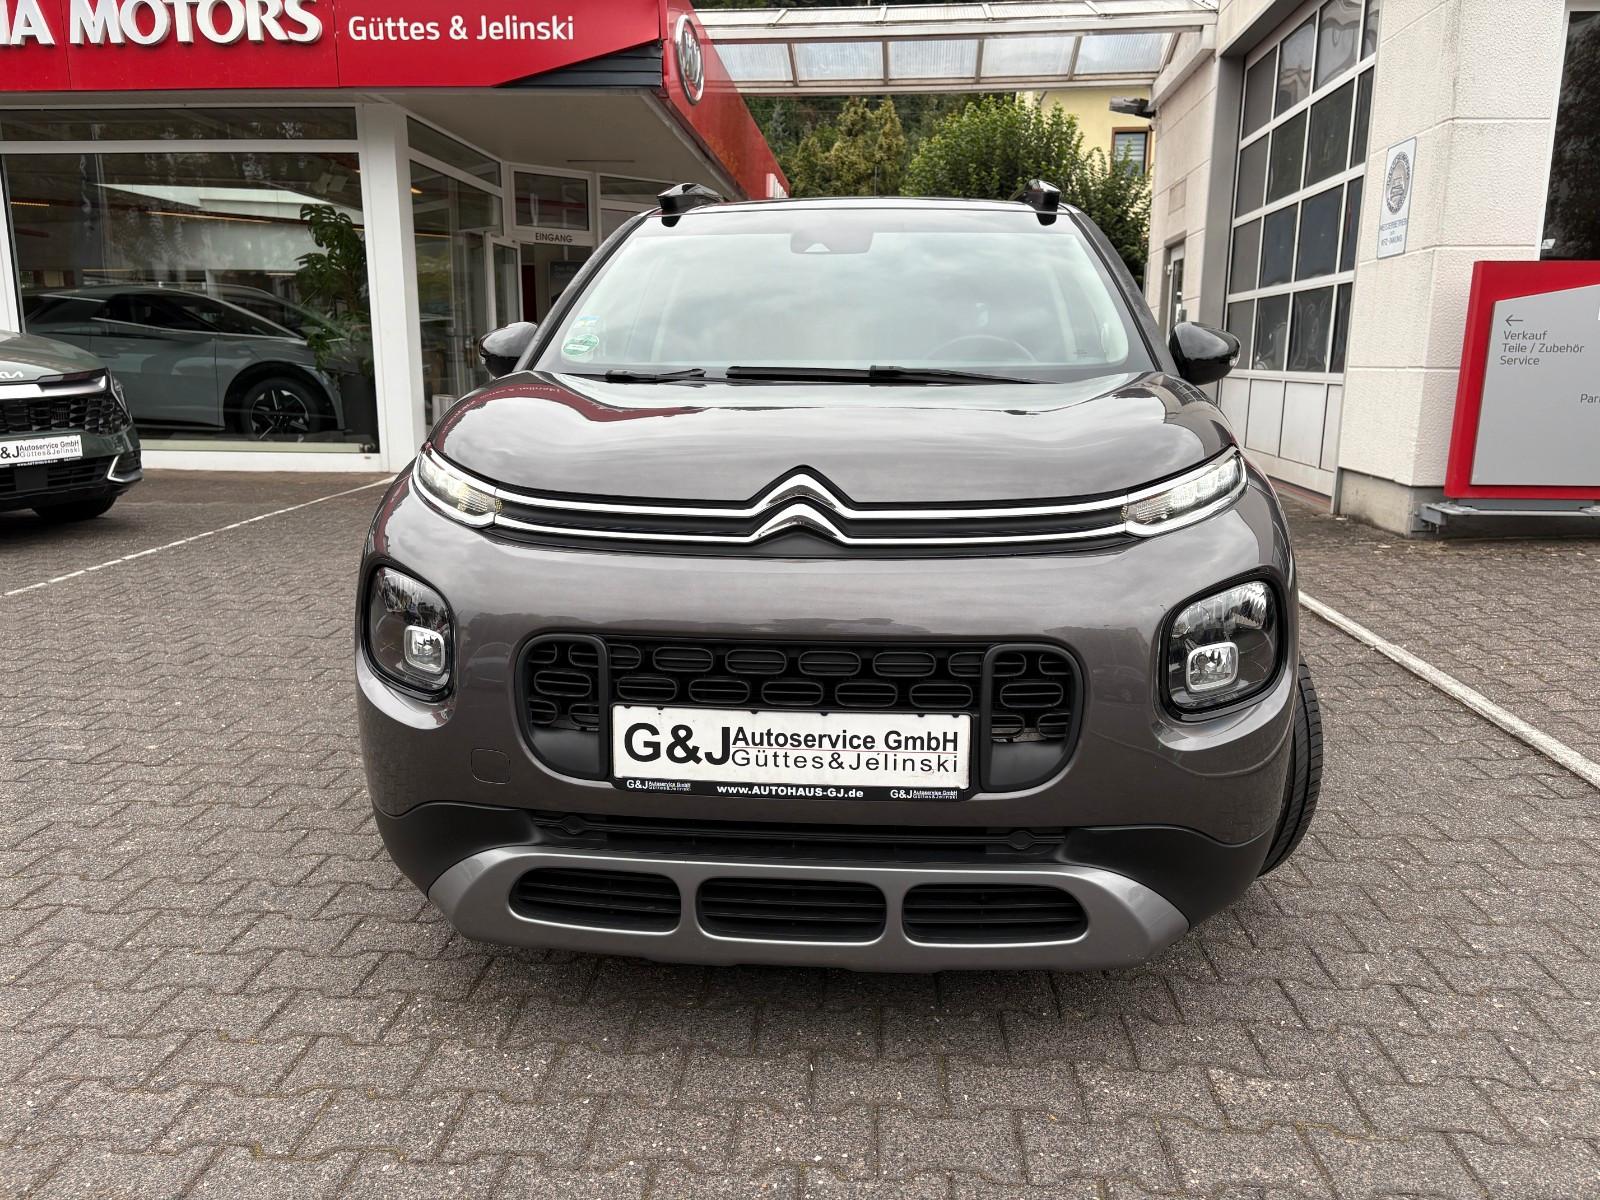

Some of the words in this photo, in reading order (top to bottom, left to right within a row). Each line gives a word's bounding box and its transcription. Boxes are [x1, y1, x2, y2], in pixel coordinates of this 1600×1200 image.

[69, 0, 323, 46] MOTORS
[348, 15, 441, 41] Güttes
[449, 15, 468, 41] &
[476, 15, 574, 41] Jelinski
[535, 231, 574, 243] EINGANG
[1503, 330, 1548, 341] Verkauf
[1502, 342, 1527, 353] Teile
[1538, 342, 1585, 353] Zubehör
[1500, 355, 1540, 366] Service
[20, 444, 59, 452] Autoservice
[60, 440, 79, 448] GmbH
[624, 722, 732, 766] G&J
[732, 726, 876, 750] Autoservice
[884, 730, 958, 752] GmbH
[626, 779, 649, 790] G&J
[716, 785, 864, 798] www.AUTOHAUS-GJ.de
[890, 789, 913, 799] G&J
